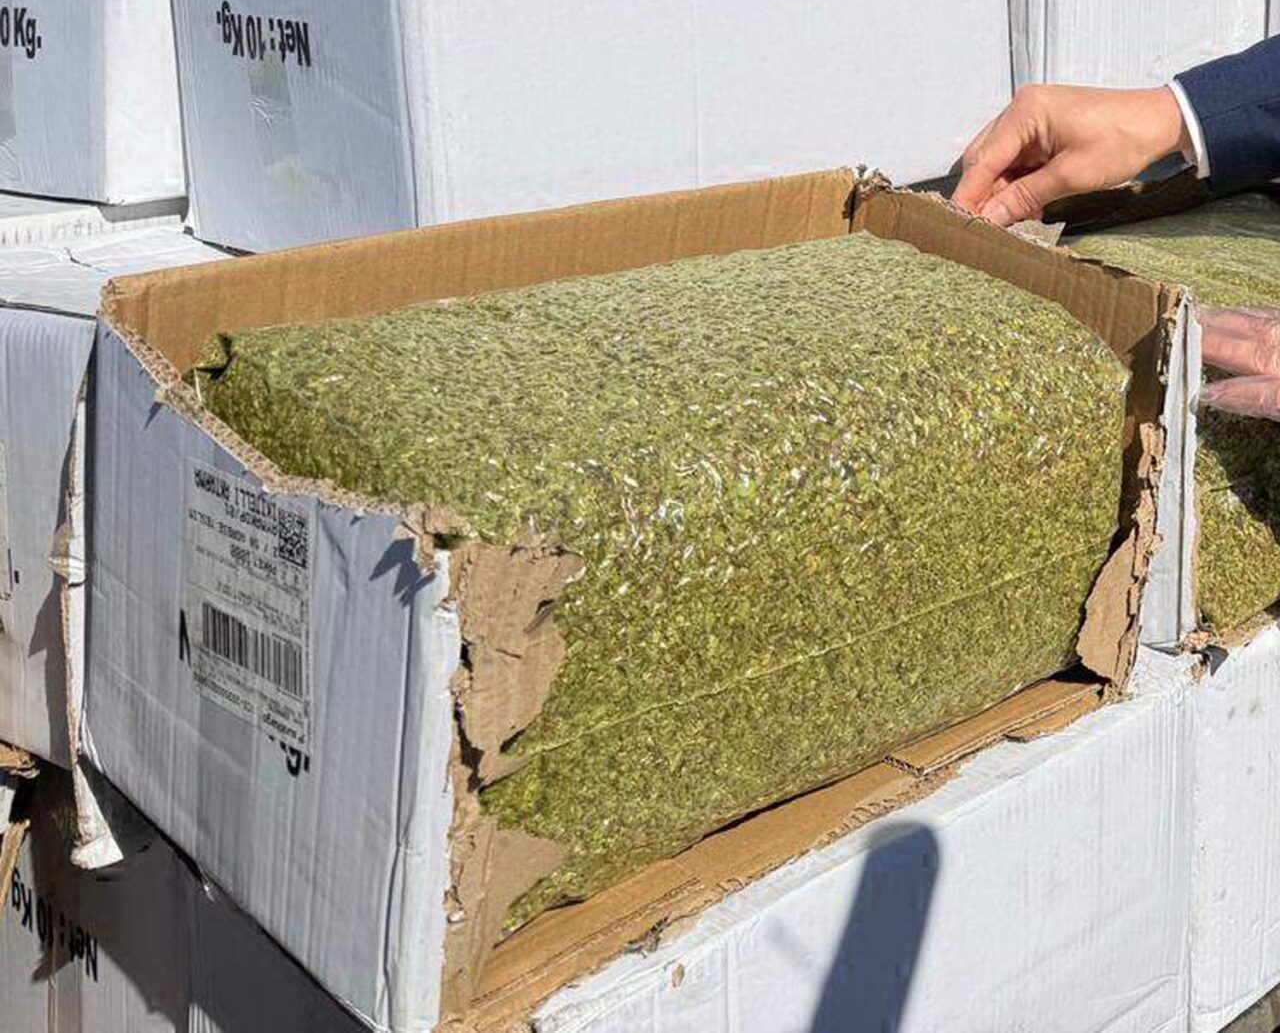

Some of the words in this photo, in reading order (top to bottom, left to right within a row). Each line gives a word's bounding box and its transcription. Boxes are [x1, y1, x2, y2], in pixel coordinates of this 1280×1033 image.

[14, 7, 42, 59] Kg.
[216, 0, 244, 58] Kg.
[246, 15, 266, 61] 10
[277, 18, 311, 68] Net
